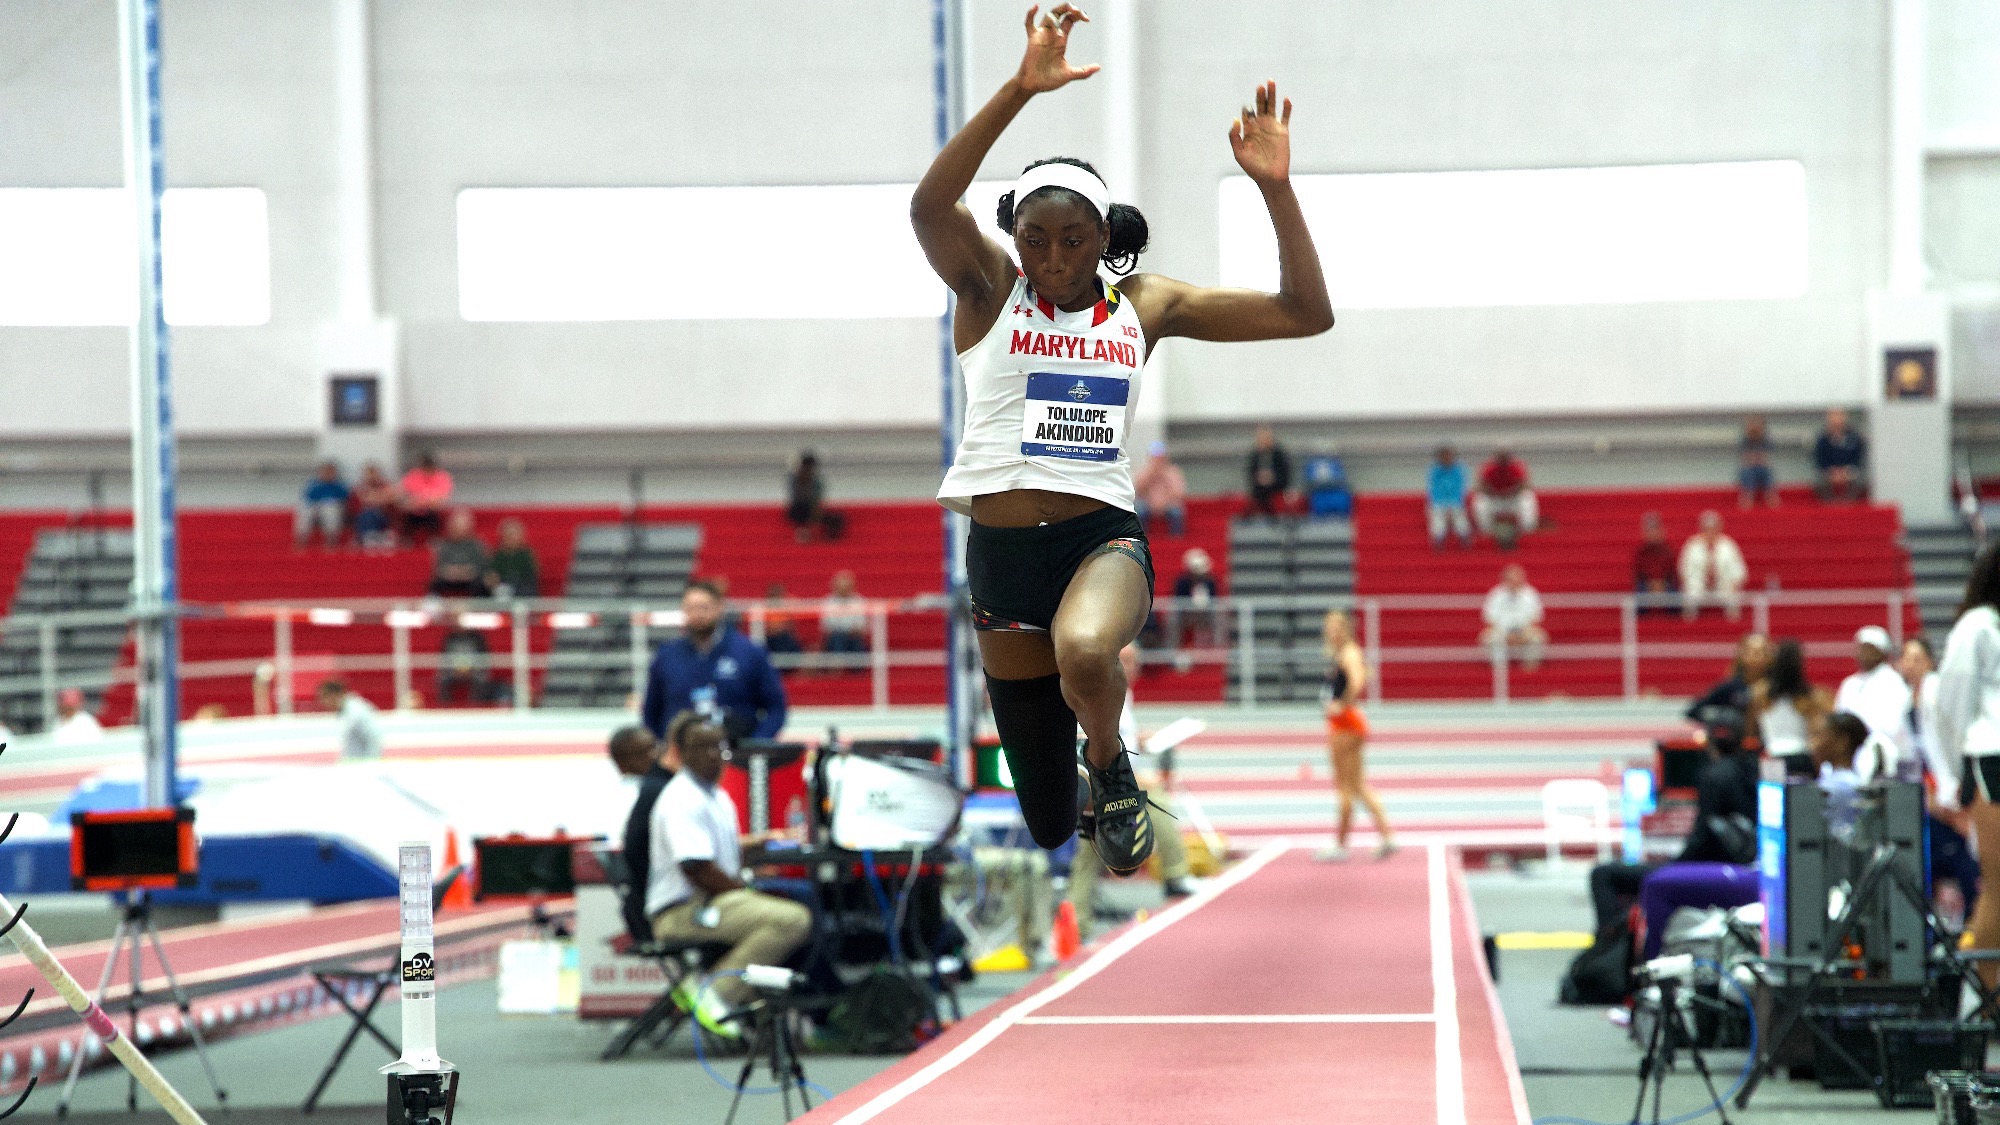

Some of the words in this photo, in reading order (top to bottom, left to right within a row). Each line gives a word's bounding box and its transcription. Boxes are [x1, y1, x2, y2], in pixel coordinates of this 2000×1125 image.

[1009, 330, 1136, 368] MARYLAND
[1047, 406, 1107, 423] TOLULOPE
[1035, 423, 1113, 444] AKINDURO
[1104, 798, 1138, 813] ADIZERO
[412, 958, 431, 968] DV
